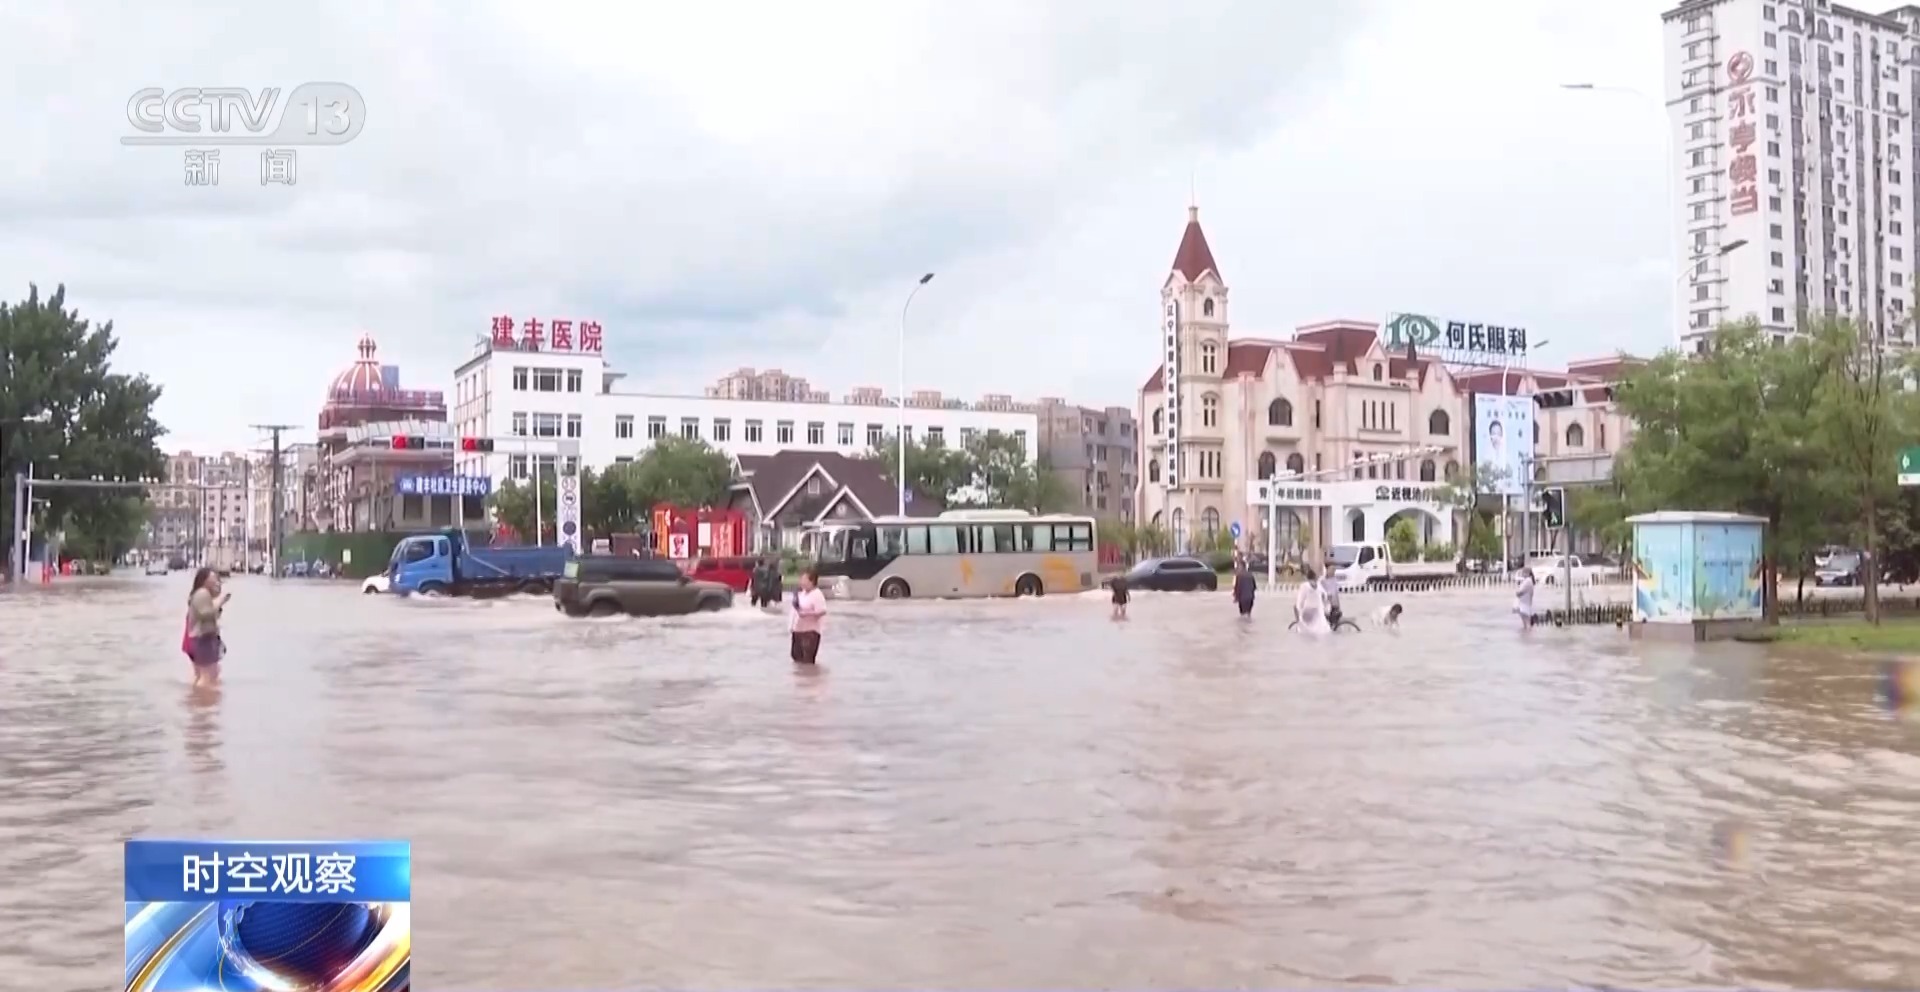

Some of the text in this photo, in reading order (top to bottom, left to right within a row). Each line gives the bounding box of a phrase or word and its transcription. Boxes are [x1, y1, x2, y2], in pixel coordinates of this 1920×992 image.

[492, 315, 603, 352] 建丰医院
[1446, 320, 1527, 355] 何氏眼科
